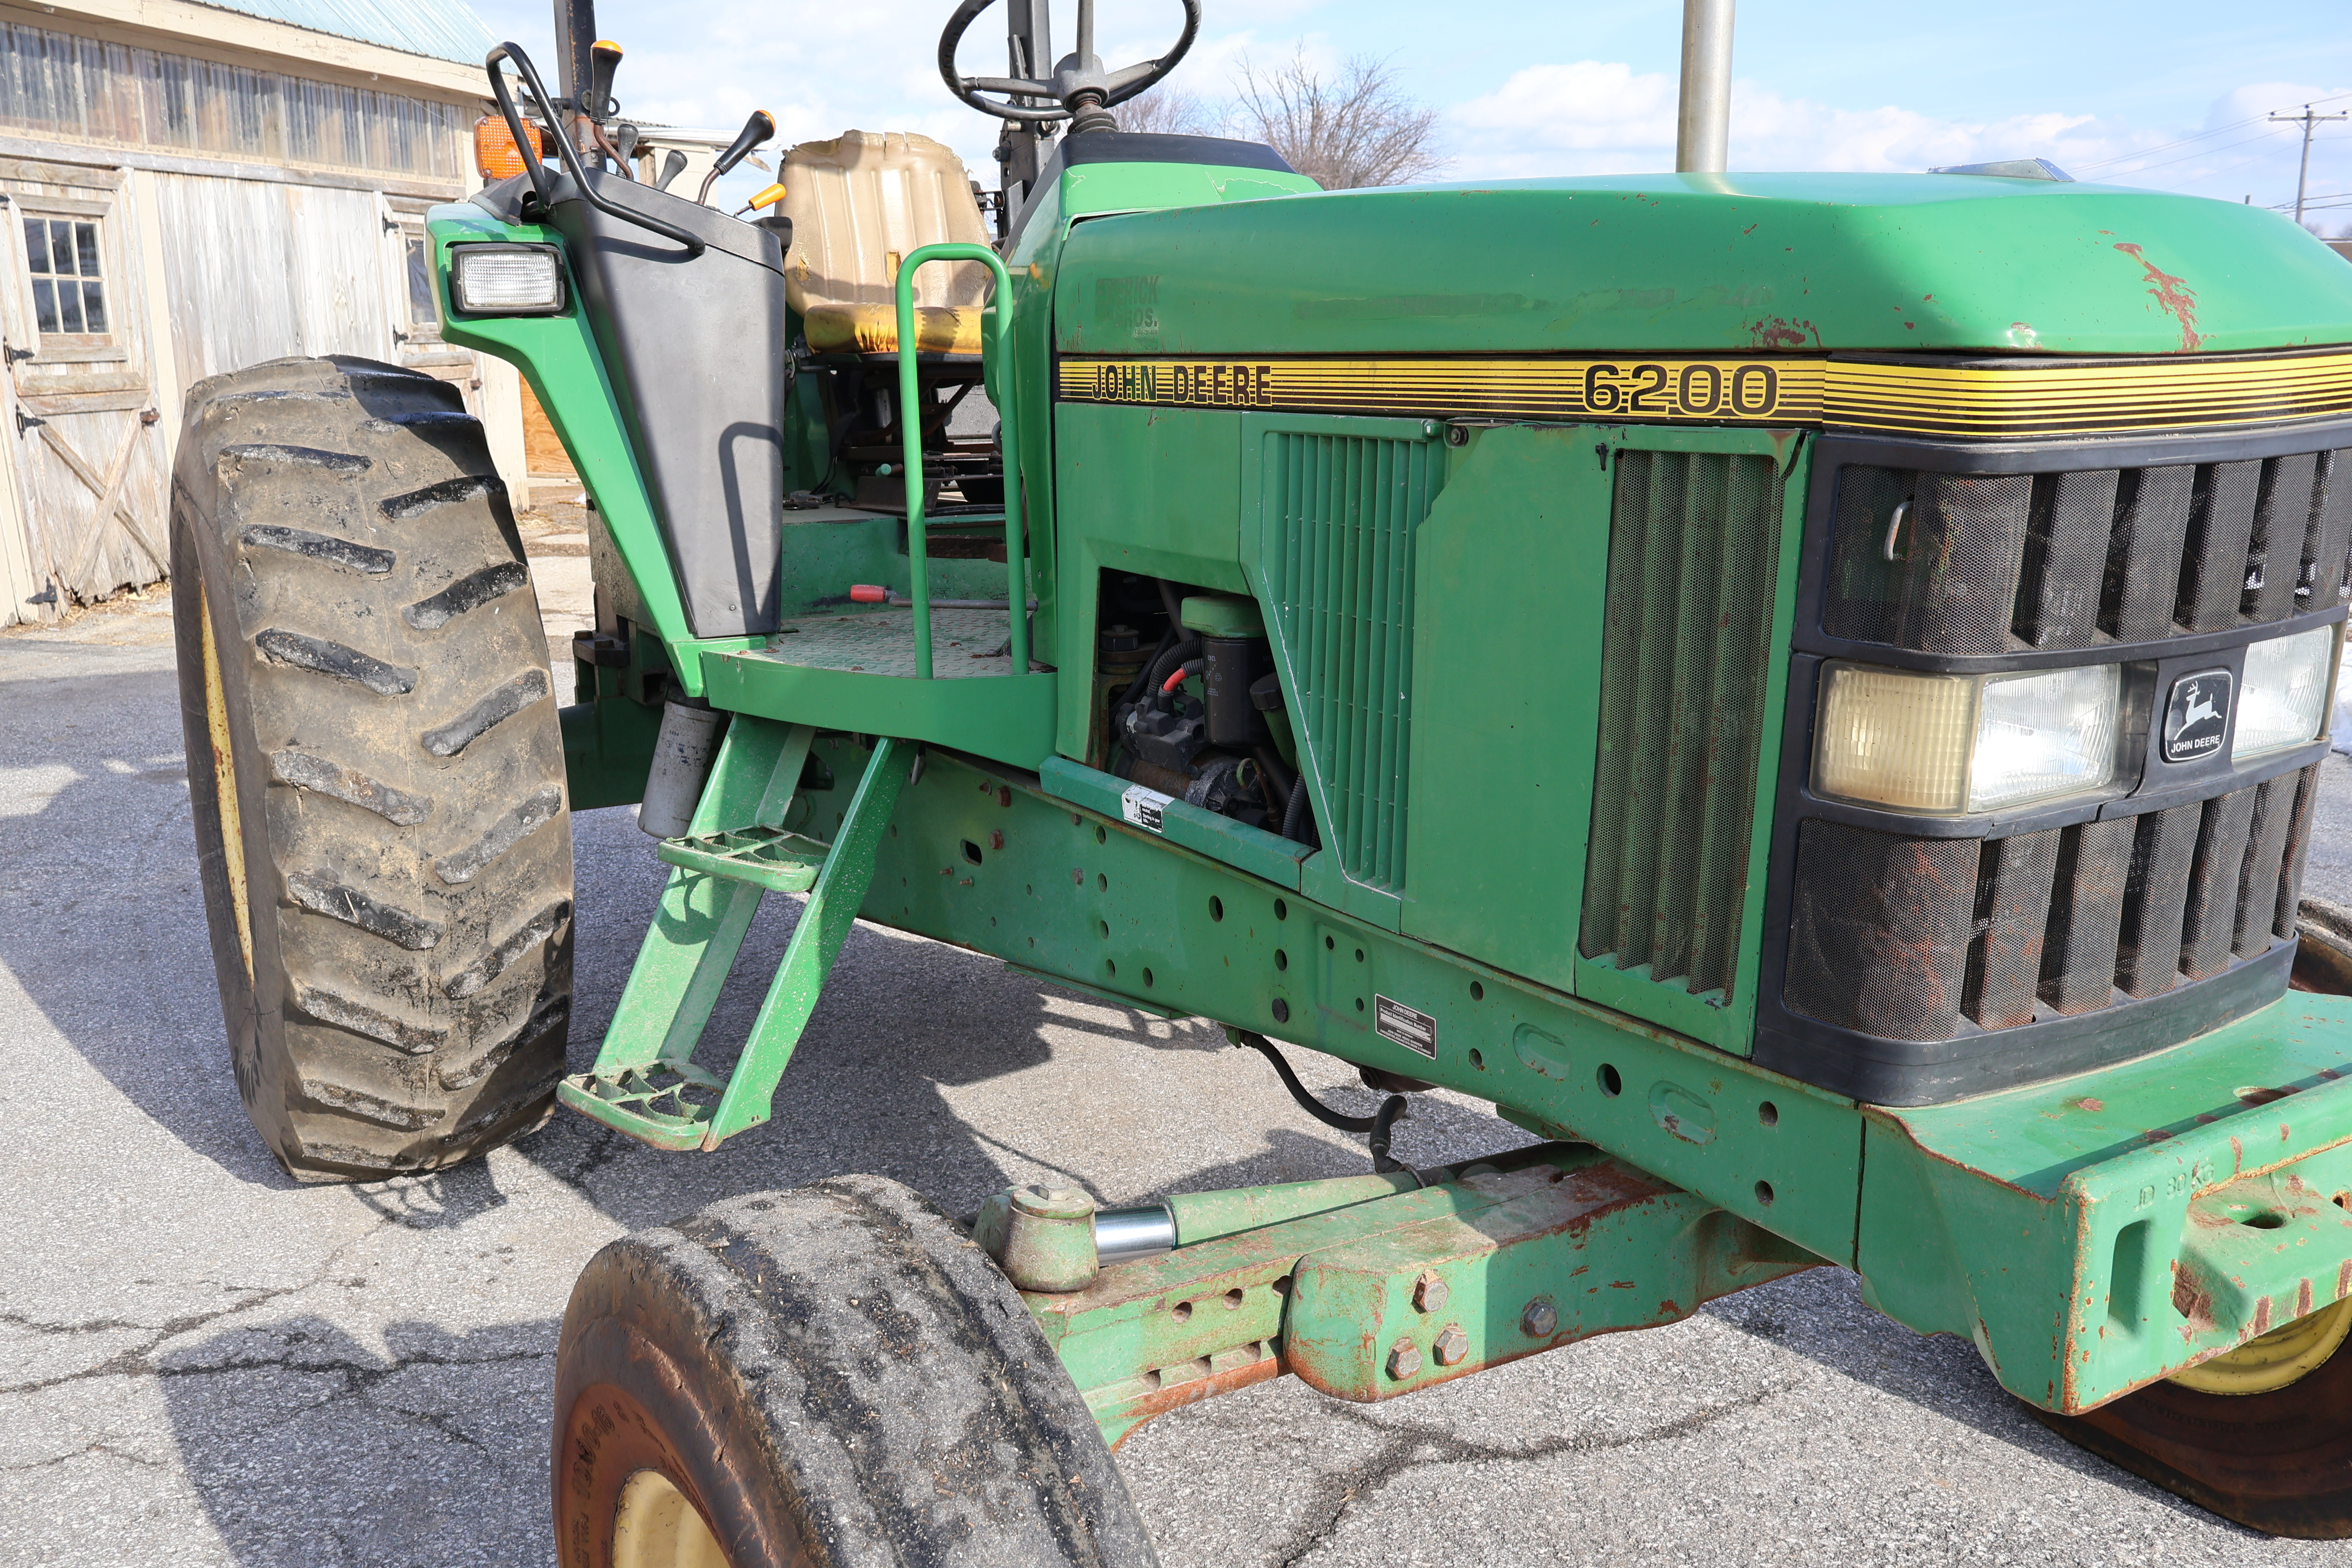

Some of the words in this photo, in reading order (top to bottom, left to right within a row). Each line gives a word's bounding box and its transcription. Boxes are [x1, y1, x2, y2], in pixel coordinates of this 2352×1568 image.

[1092, 365, 1157, 403] JOHN
[1173, 365, 1272, 407] DEERE
[1583, 361, 1780, 417] 6200
[2171, 740, 2193, 753] JOHN
[2194, 735, 2220, 748] DEERE
[1380, 1007, 1392, 1016] Product
[1392, 1013, 1413, 1025] Identification
[1414, 1022, 1426, 1031] Number
[1392, 1004, 1404, 1014] JOHN
[1404, 1009, 1417, 1020] DEERE
